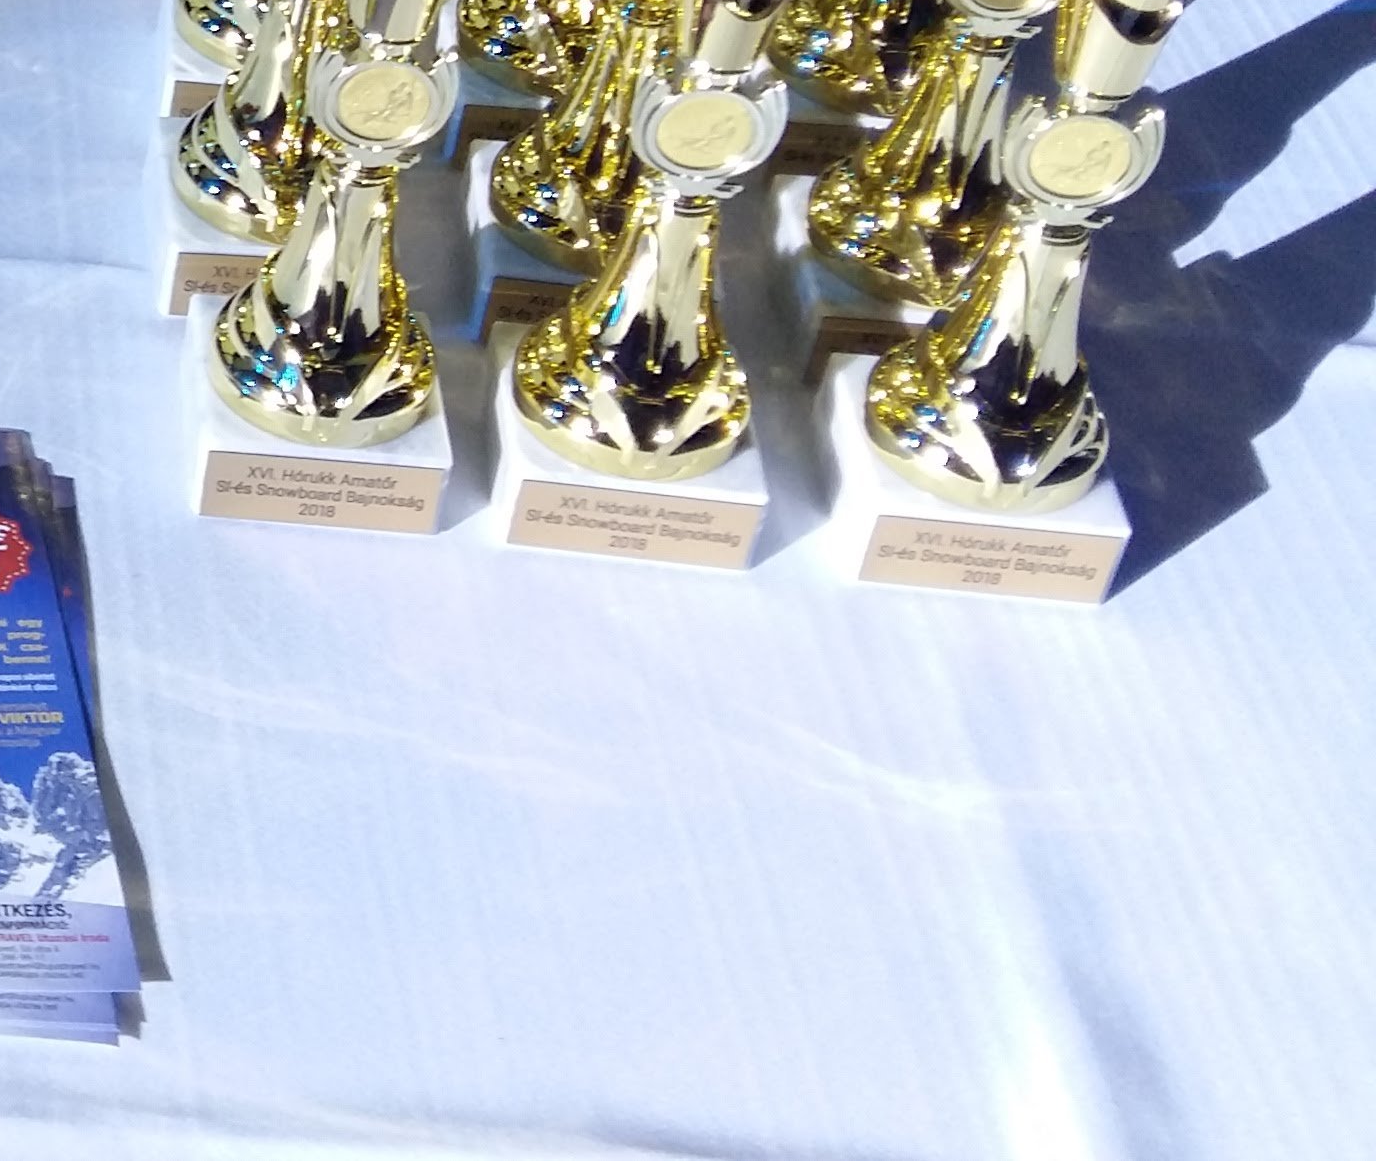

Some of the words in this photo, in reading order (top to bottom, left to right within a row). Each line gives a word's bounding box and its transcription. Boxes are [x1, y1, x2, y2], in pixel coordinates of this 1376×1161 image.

[248, 466, 276, 480] XVI.
[282, 469, 335, 485] Hórukk
[255, 482, 342, 503] Snowboard
[348, 490, 425, 512] Bajnokság
[298, 503, 336, 518] 2018
[567, 513, 655, 536] Snowboard
[608, 535, 647, 550] 2018
[920, 549, 1012, 570] Snowboard
[961, 570, 1003, 585] 2018
